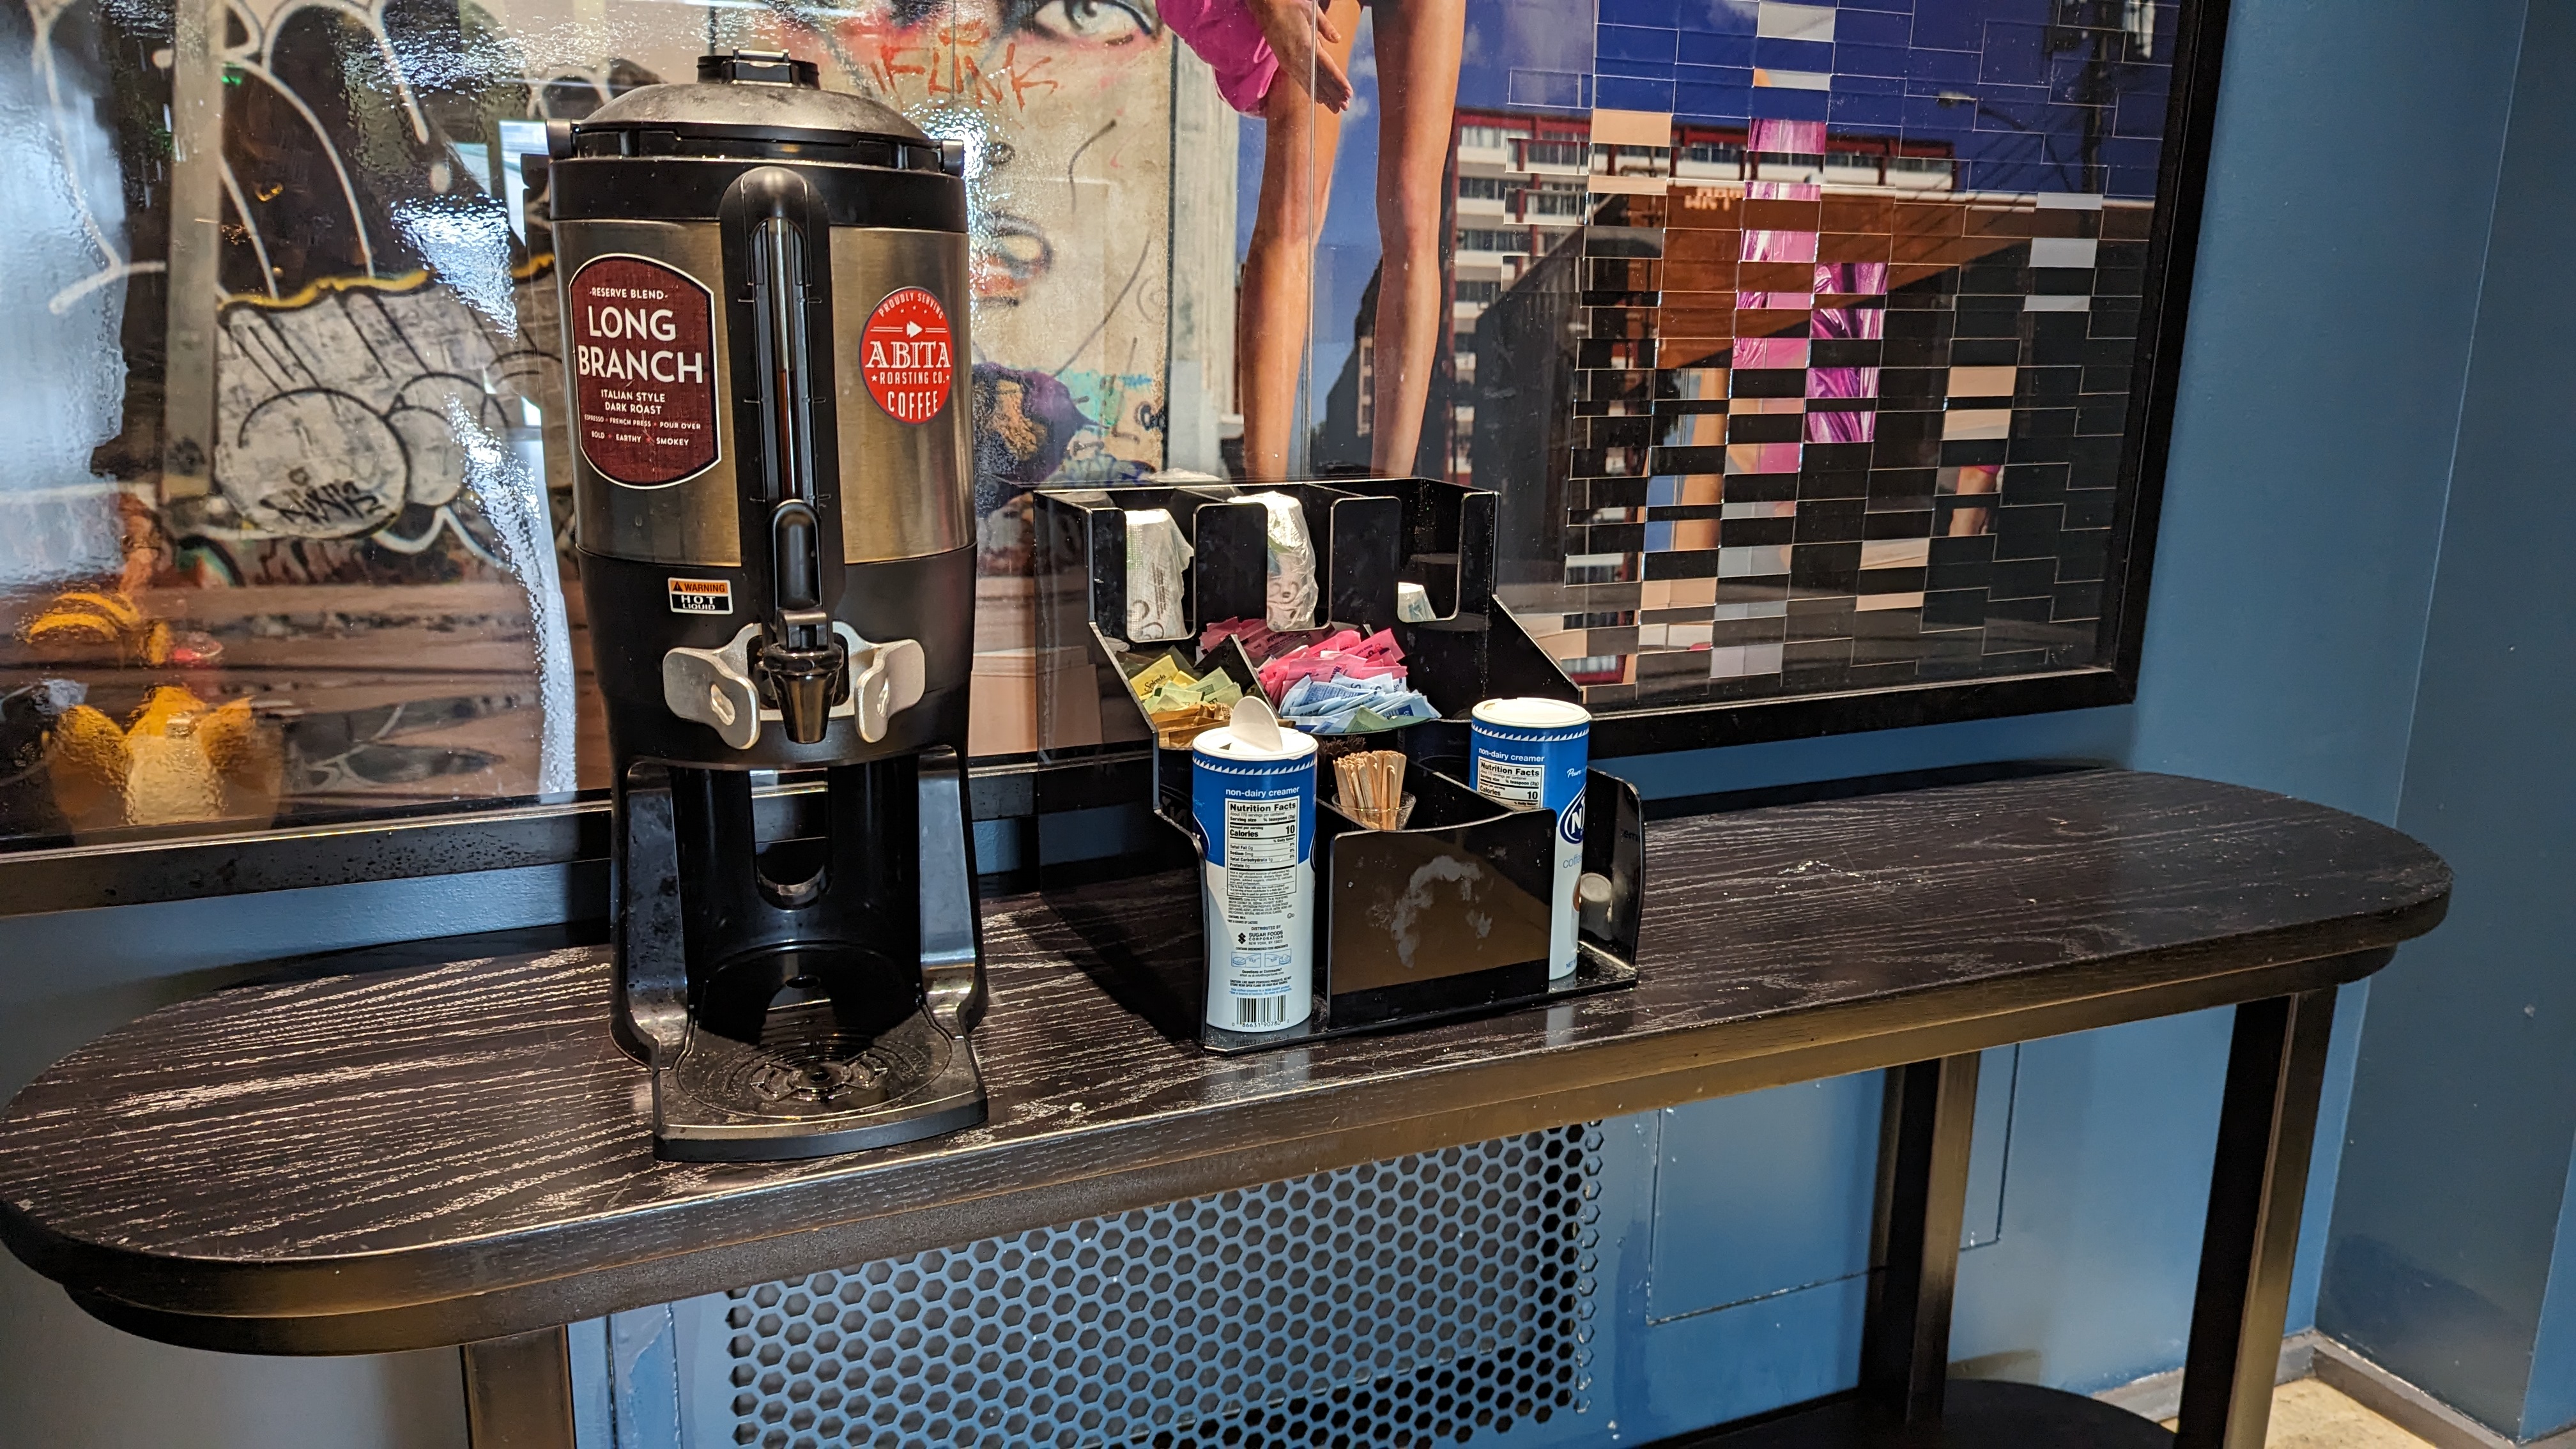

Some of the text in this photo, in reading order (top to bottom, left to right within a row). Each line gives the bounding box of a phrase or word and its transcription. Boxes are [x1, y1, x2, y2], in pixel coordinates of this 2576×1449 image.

[878, 293, 944, 319] PROUDLY SERVING
[588, 305, 677, 341] LONG
[865, 341, 951, 368] ABITA
[578, 345, 703, 383] BRANCH
[880, 371, 945, 384] ROASTING CO.
[601, 388, 666, 402] ITALIAN STYLE
[605, 402, 662, 415] DARK ROAST
[888, 391, 938, 419] COFFEE
[592, 431, 689, 446] BOLD EARTHY SMOKEY
[684, 583, 724, 592] WARNING
[681, 595, 716, 604] HOT
[1479, 748, 1508, 760] non-dairy
[1480, 762, 1512, 774] Nutrition
[1225, 786, 1300, 798] non-dairy creamer
[1480, 785, 1538, 799] Calories 10
[1230, 802, 1296, 812] Nutrition Facts
[1286, 825, 1295, 834] 10
